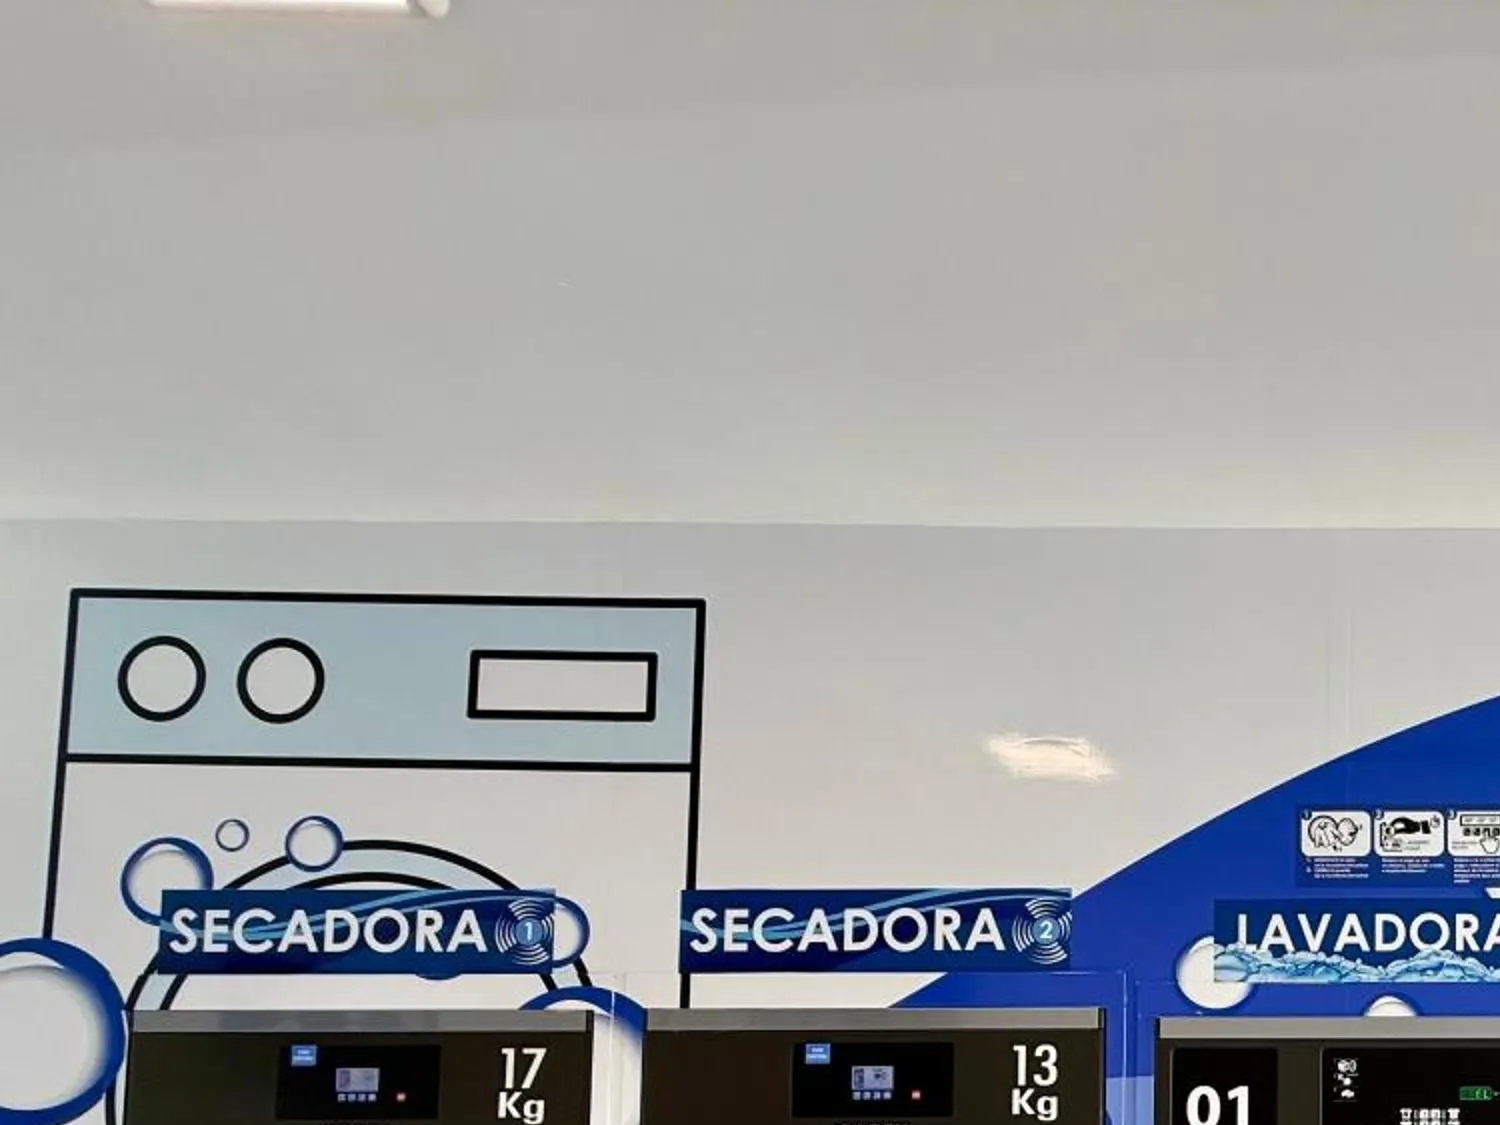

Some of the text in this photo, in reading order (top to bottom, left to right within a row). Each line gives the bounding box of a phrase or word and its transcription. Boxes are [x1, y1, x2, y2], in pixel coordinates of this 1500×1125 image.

[169, 909, 533, 954] SECADORA 1
[690, 908, 1053, 952] SECADORA 2
[501, 1048, 546, 1089] 17
[1013, 1045, 1058, 1086] 13
[498, 1093, 545, 1124] Kg
[1012, 1090, 1058, 1121] Kg
